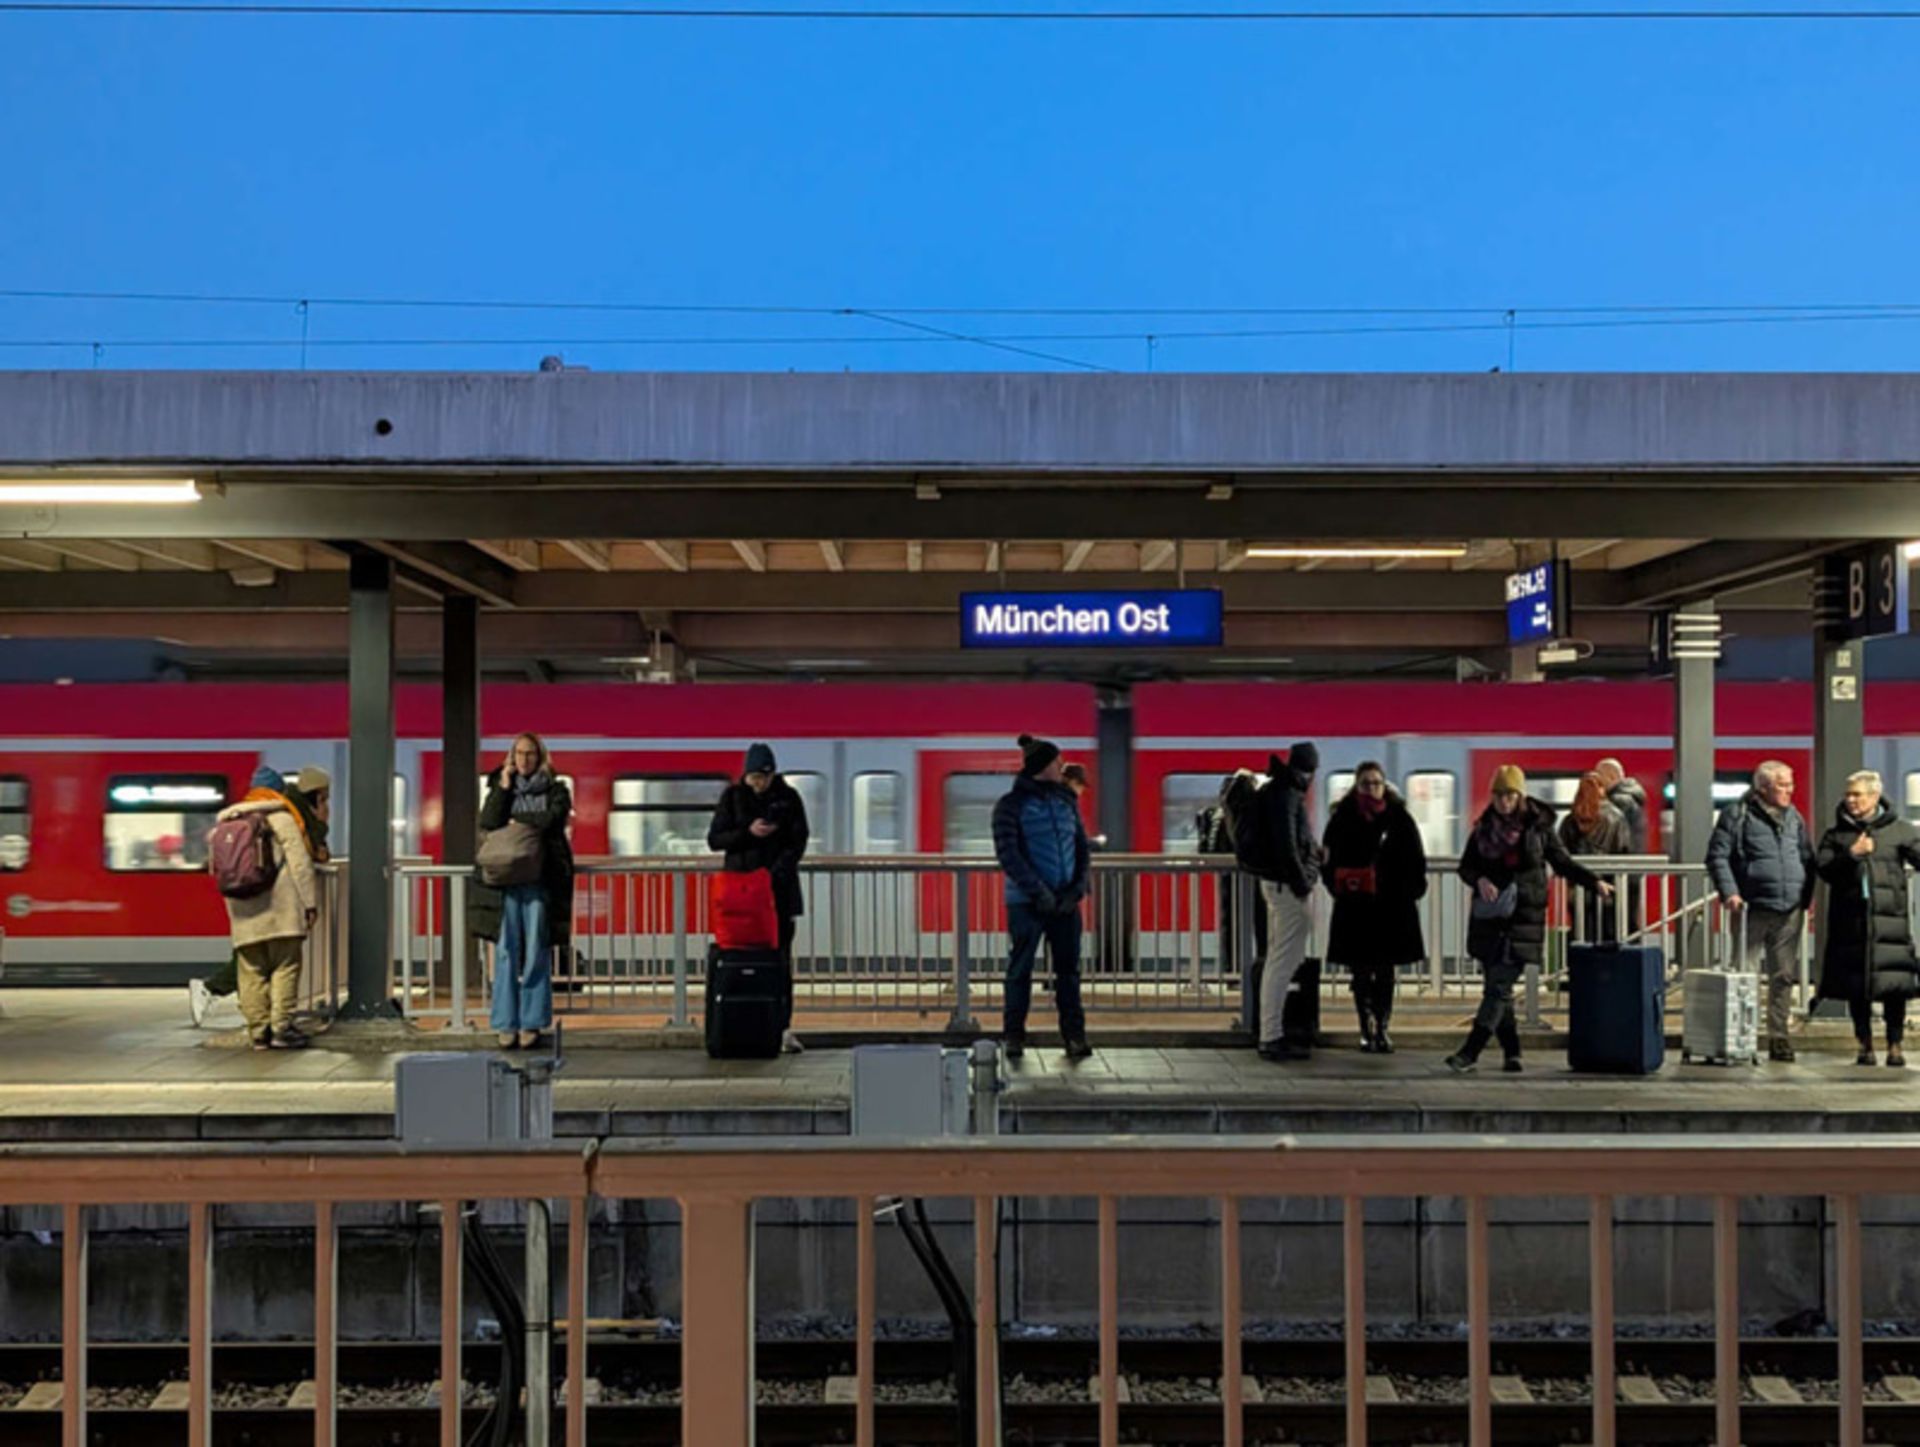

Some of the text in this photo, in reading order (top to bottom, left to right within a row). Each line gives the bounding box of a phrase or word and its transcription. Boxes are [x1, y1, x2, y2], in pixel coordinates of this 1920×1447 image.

[1850, 554, 1894, 618] B 3
[975, 602, 1170, 635] München Ost
